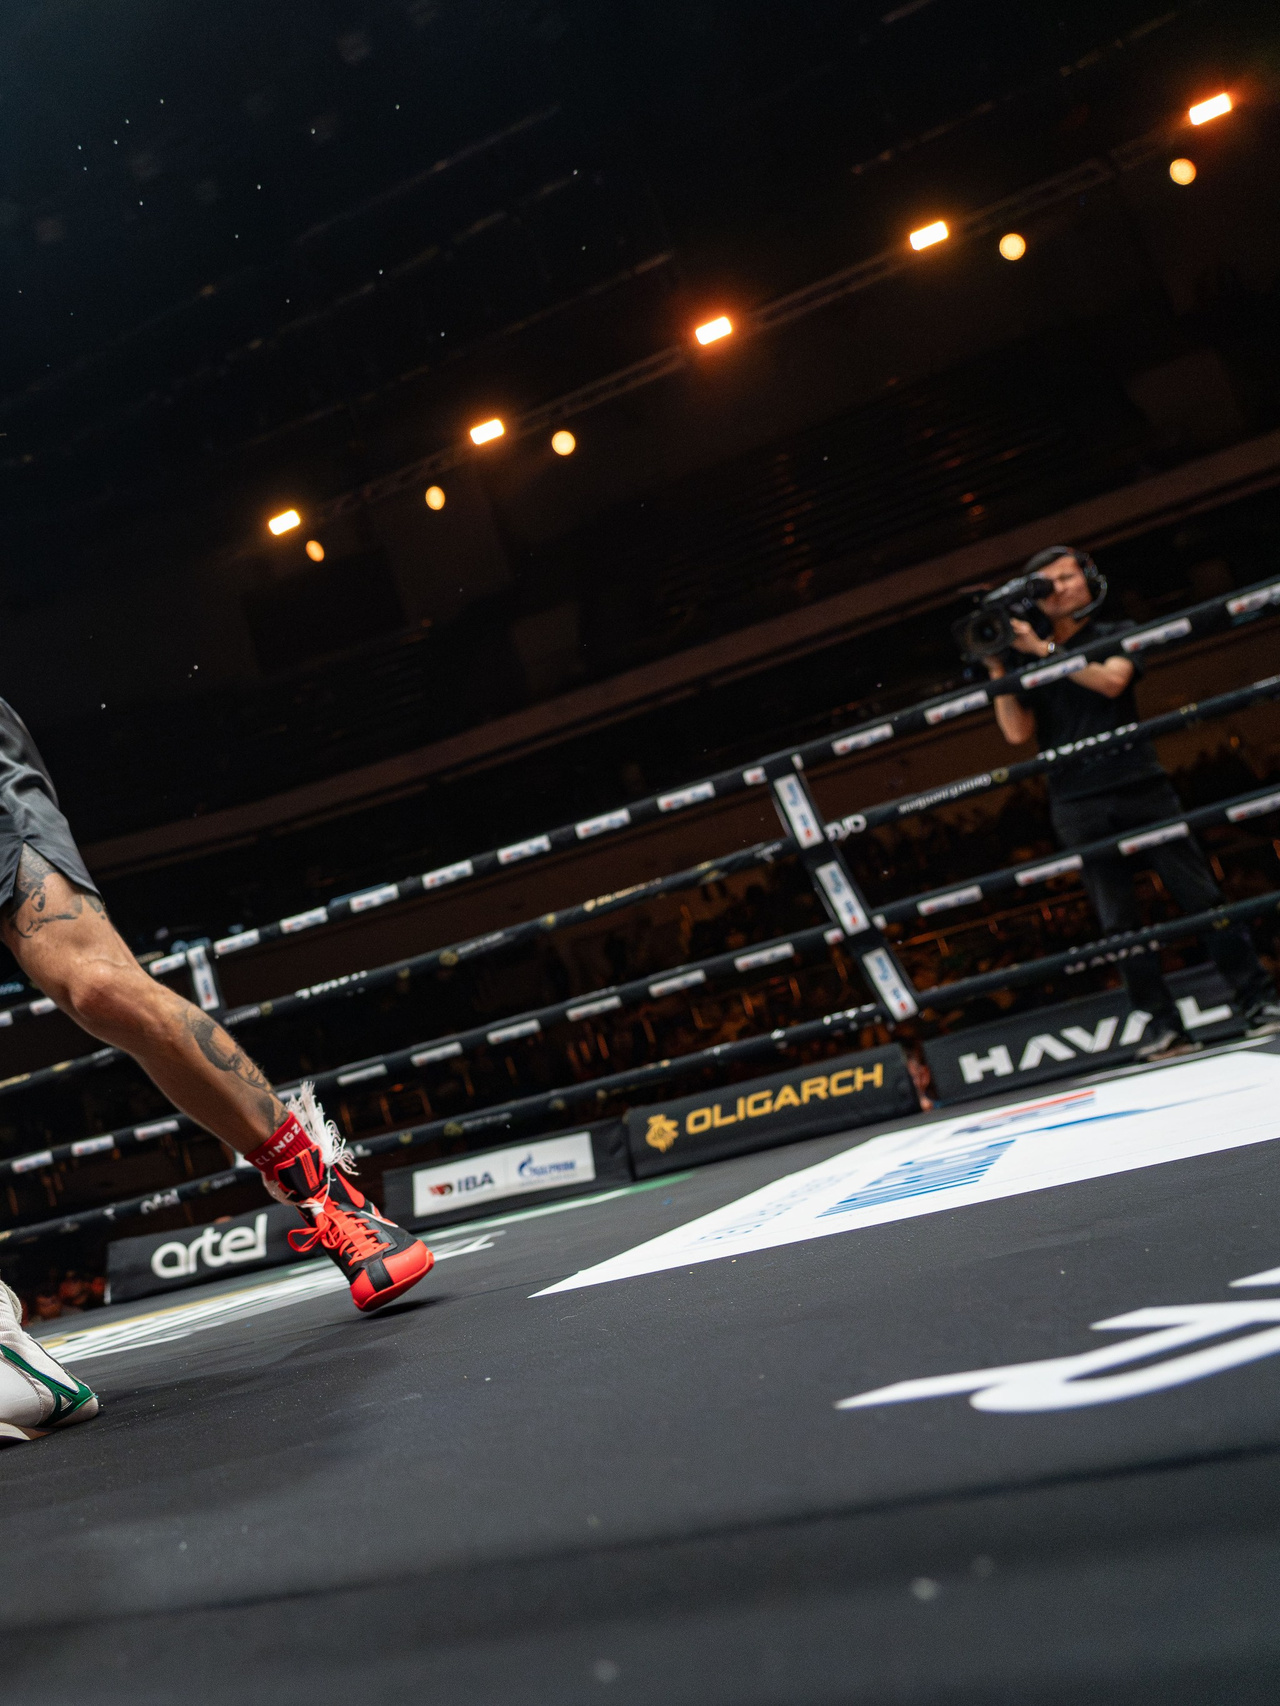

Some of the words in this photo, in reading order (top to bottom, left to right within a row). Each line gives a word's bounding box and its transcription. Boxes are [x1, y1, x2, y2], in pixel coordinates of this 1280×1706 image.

[685, 1062, 884, 1136] OLIGARCH
[255, 1122, 301, 1166] CLINGZ
[458, 1171, 495, 1193] IBA
[151, 1213, 268, 1279] artel
